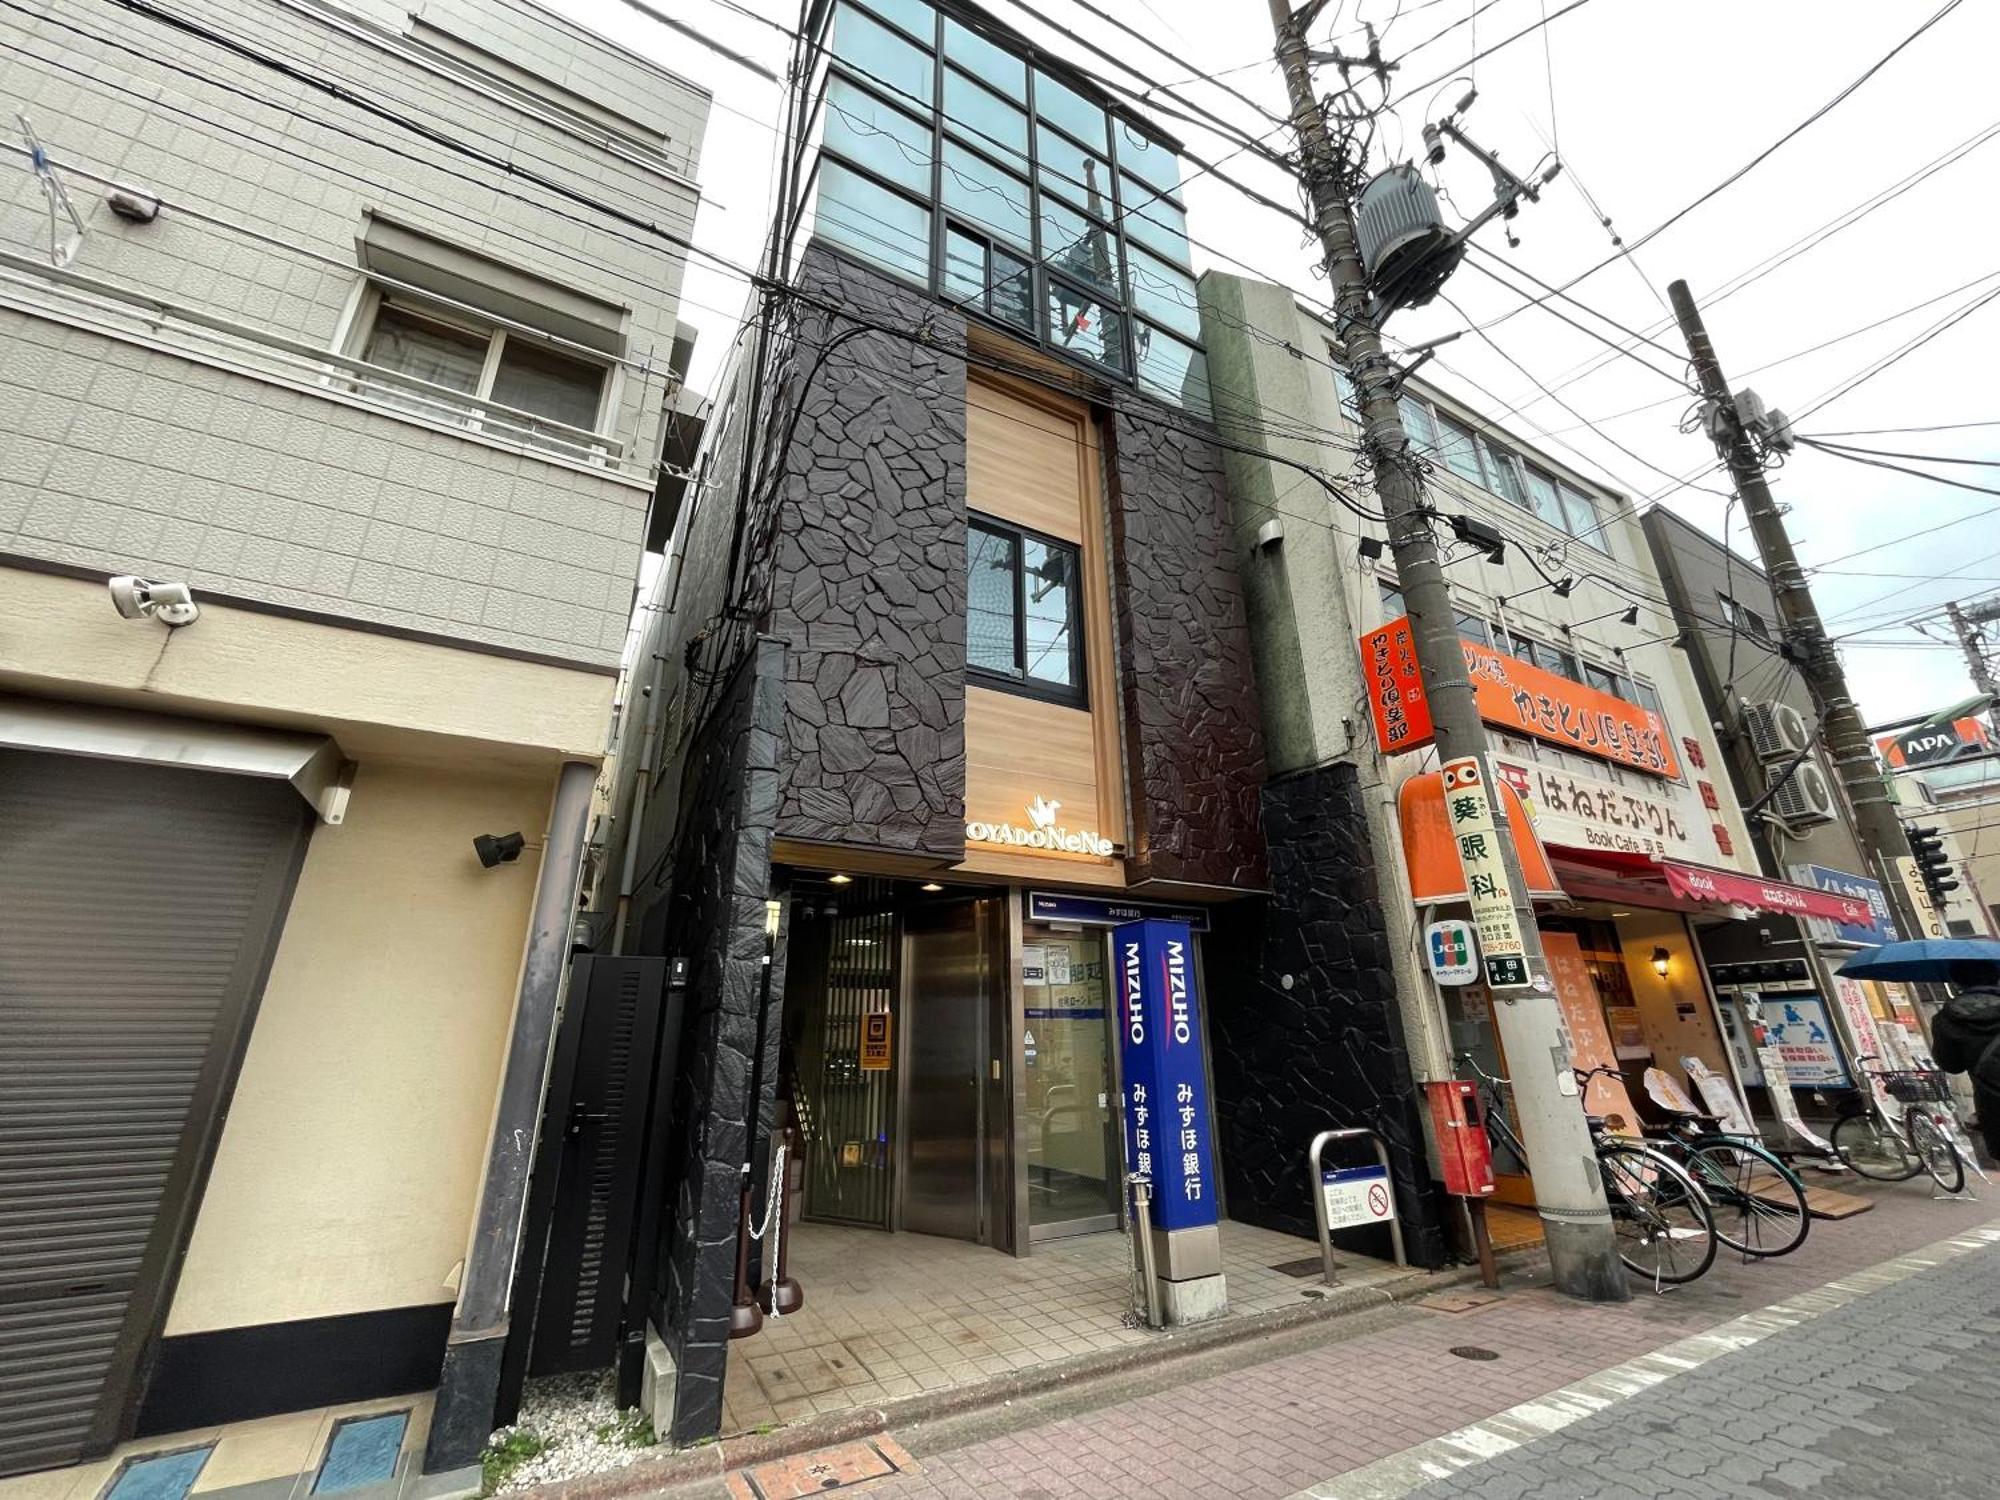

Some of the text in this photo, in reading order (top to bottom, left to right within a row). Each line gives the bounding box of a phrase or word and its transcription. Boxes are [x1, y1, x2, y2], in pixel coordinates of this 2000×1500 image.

[1907, 734, 1953, 754] APA
[1452, 796, 1498, 900] 葵眼科
[1538, 771, 1686, 841] はねだぷりん
[1585, 827, 1614, 848] Book
[1615, 834, 1640, 853] Cafe
[1433, 943, 1465, 953] JCB
[1125, 942, 1145, 1045] MIZUHO
[1167, 940, 1191, 1044] MIZUHO
[1177, 1083, 1202, 1200] みずほ銀行
